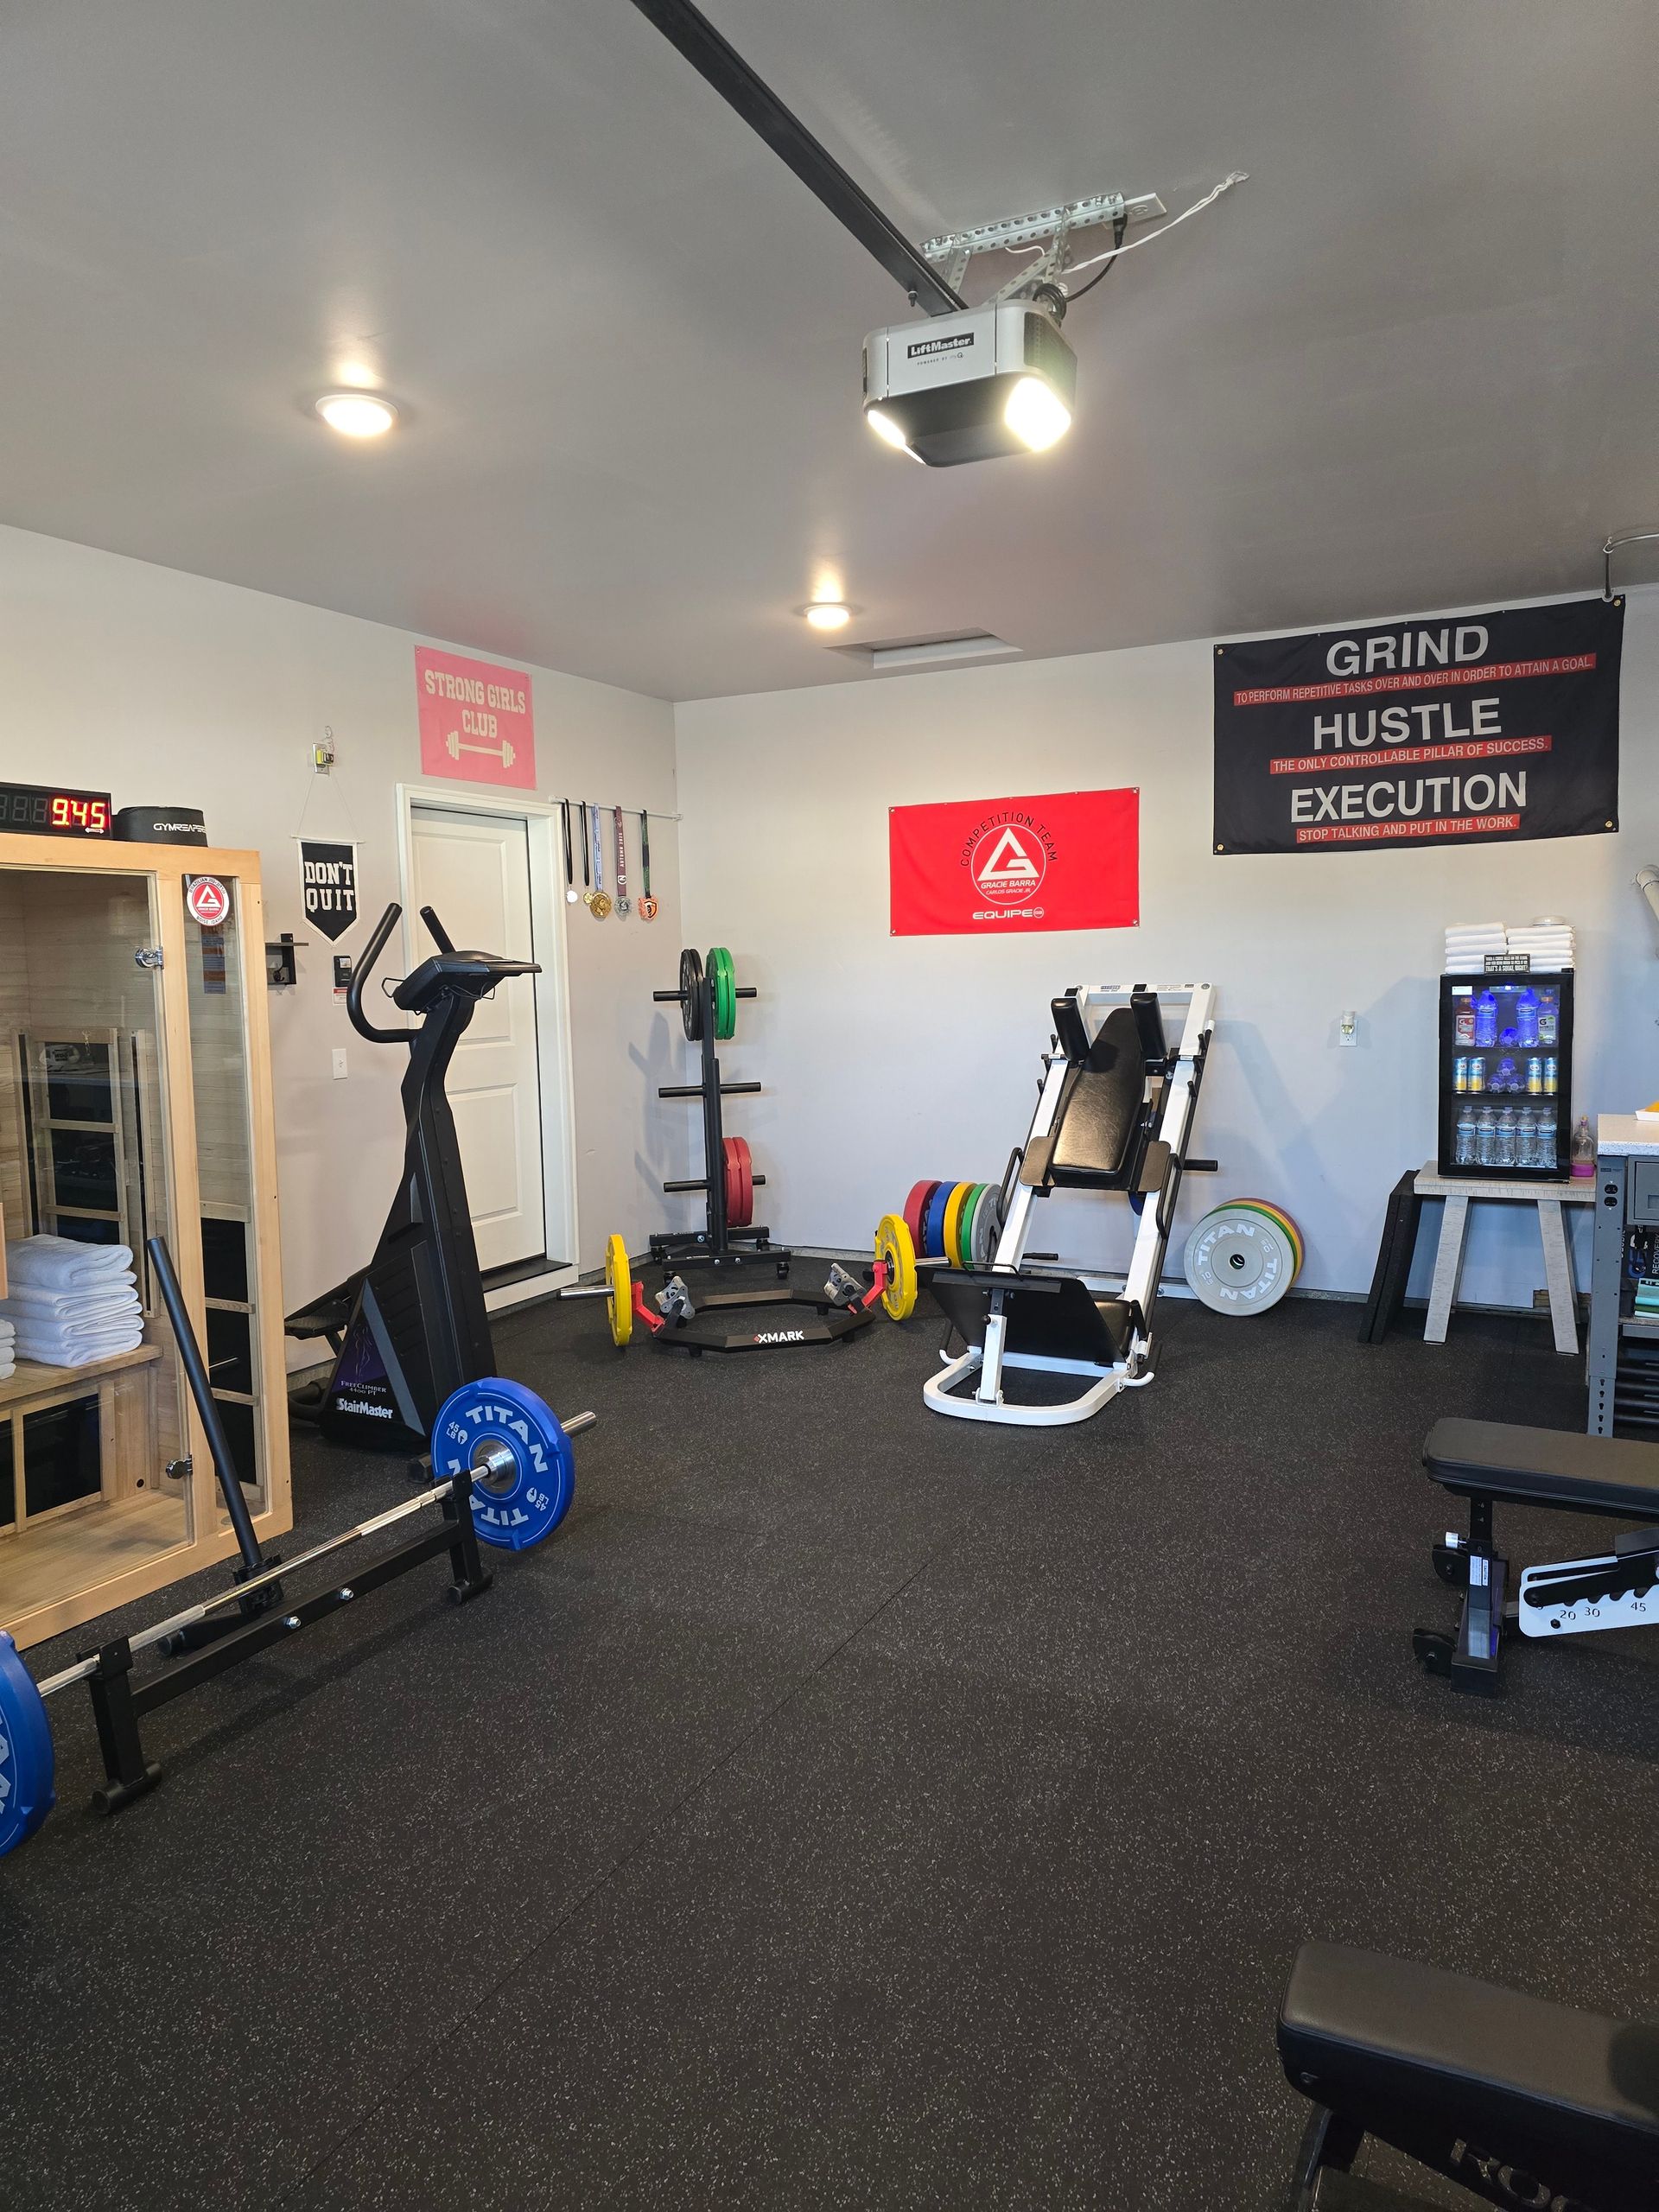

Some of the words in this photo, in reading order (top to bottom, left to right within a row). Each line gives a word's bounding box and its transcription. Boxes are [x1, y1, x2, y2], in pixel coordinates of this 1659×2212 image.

[1326, 626, 1489, 677] GRIND
[424, 669, 485, 706] STRONG
[487, 683, 526, 714] GIRLS
[1236, 692, 1248, 703] TO
[1249, 689, 1290, 702] PERFORM
[1293, 683, 1341, 699] REPETITIVE
[1343, 681, 1373, 694] TASKS
[1375, 677, 1400, 690] OVER
[1402, 674, 1421, 687] AND
[1424, 672, 1448, 686] OVER
[1451, 671, 1461, 683] IN
[1463, 667, 1497, 682] ORDER
[1498, 664, 1512, 677] TO
[1514, 661, 1549, 676] ATTAIN
[1552, 660, 1560, 671] A
[1561, 657, 1593, 671] GOAL.
[462, 709, 498, 738] CLUB
[1313, 697, 1502, 750] HUSTLE
[1274, 760, 1295, 772] THE
[1298, 757, 1327, 771] ONLY
[1330, 748, 1420, 767] CONTROLLABLE
[1423, 745, 1463, 759] PILLAR
[1466, 743, 1483, 755] OF
[1486, 738, 1548, 753] SUCCESS.
[1291, 771, 1527, 823] EXECUTION
[960, 811, 1034, 867] COMPETITION
[1037, 824, 1058, 862] TEAM
[1299, 829, 1329, 842] STOP
[1331, 824, 1380, 840] TALKING
[1382, 823, 1407, 836] AND
[1409, 821, 1433, 835] PUT
[1435, 820, 1447, 832] IN
[1450, 818, 1473, 831] THE
[1476, 816, 1516, 830] WORK.
[304, 861, 353, 886] DON'T
[981, 880, 1008, 889] GRACIE
[306, 888, 354, 913] QUIT
[972, 909, 1033, 920] EQUIPE
[1198, 1224, 1255, 1266] TITAN
[1201, 1271, 1211, 1281] 10
[1219, 1258, 1278, 1301] TITAN
[757, 1331, 804, 1344] XMARK
[337, 1397, 393, 1419] StairMaster
[446, 1427, 456, 1440] LB
[449, 1421, 460, 1433] 45
[466, 1406, 549, 1473] TITAN
[535, 1501, 547, 1511] 45
[539, 1493, 550, 1504] LB
[1560, 1609, 1576, 1620] 20
[1585, 1606, 1600, 1618] 30
[1630, 1601, 1647, 1612] 45
